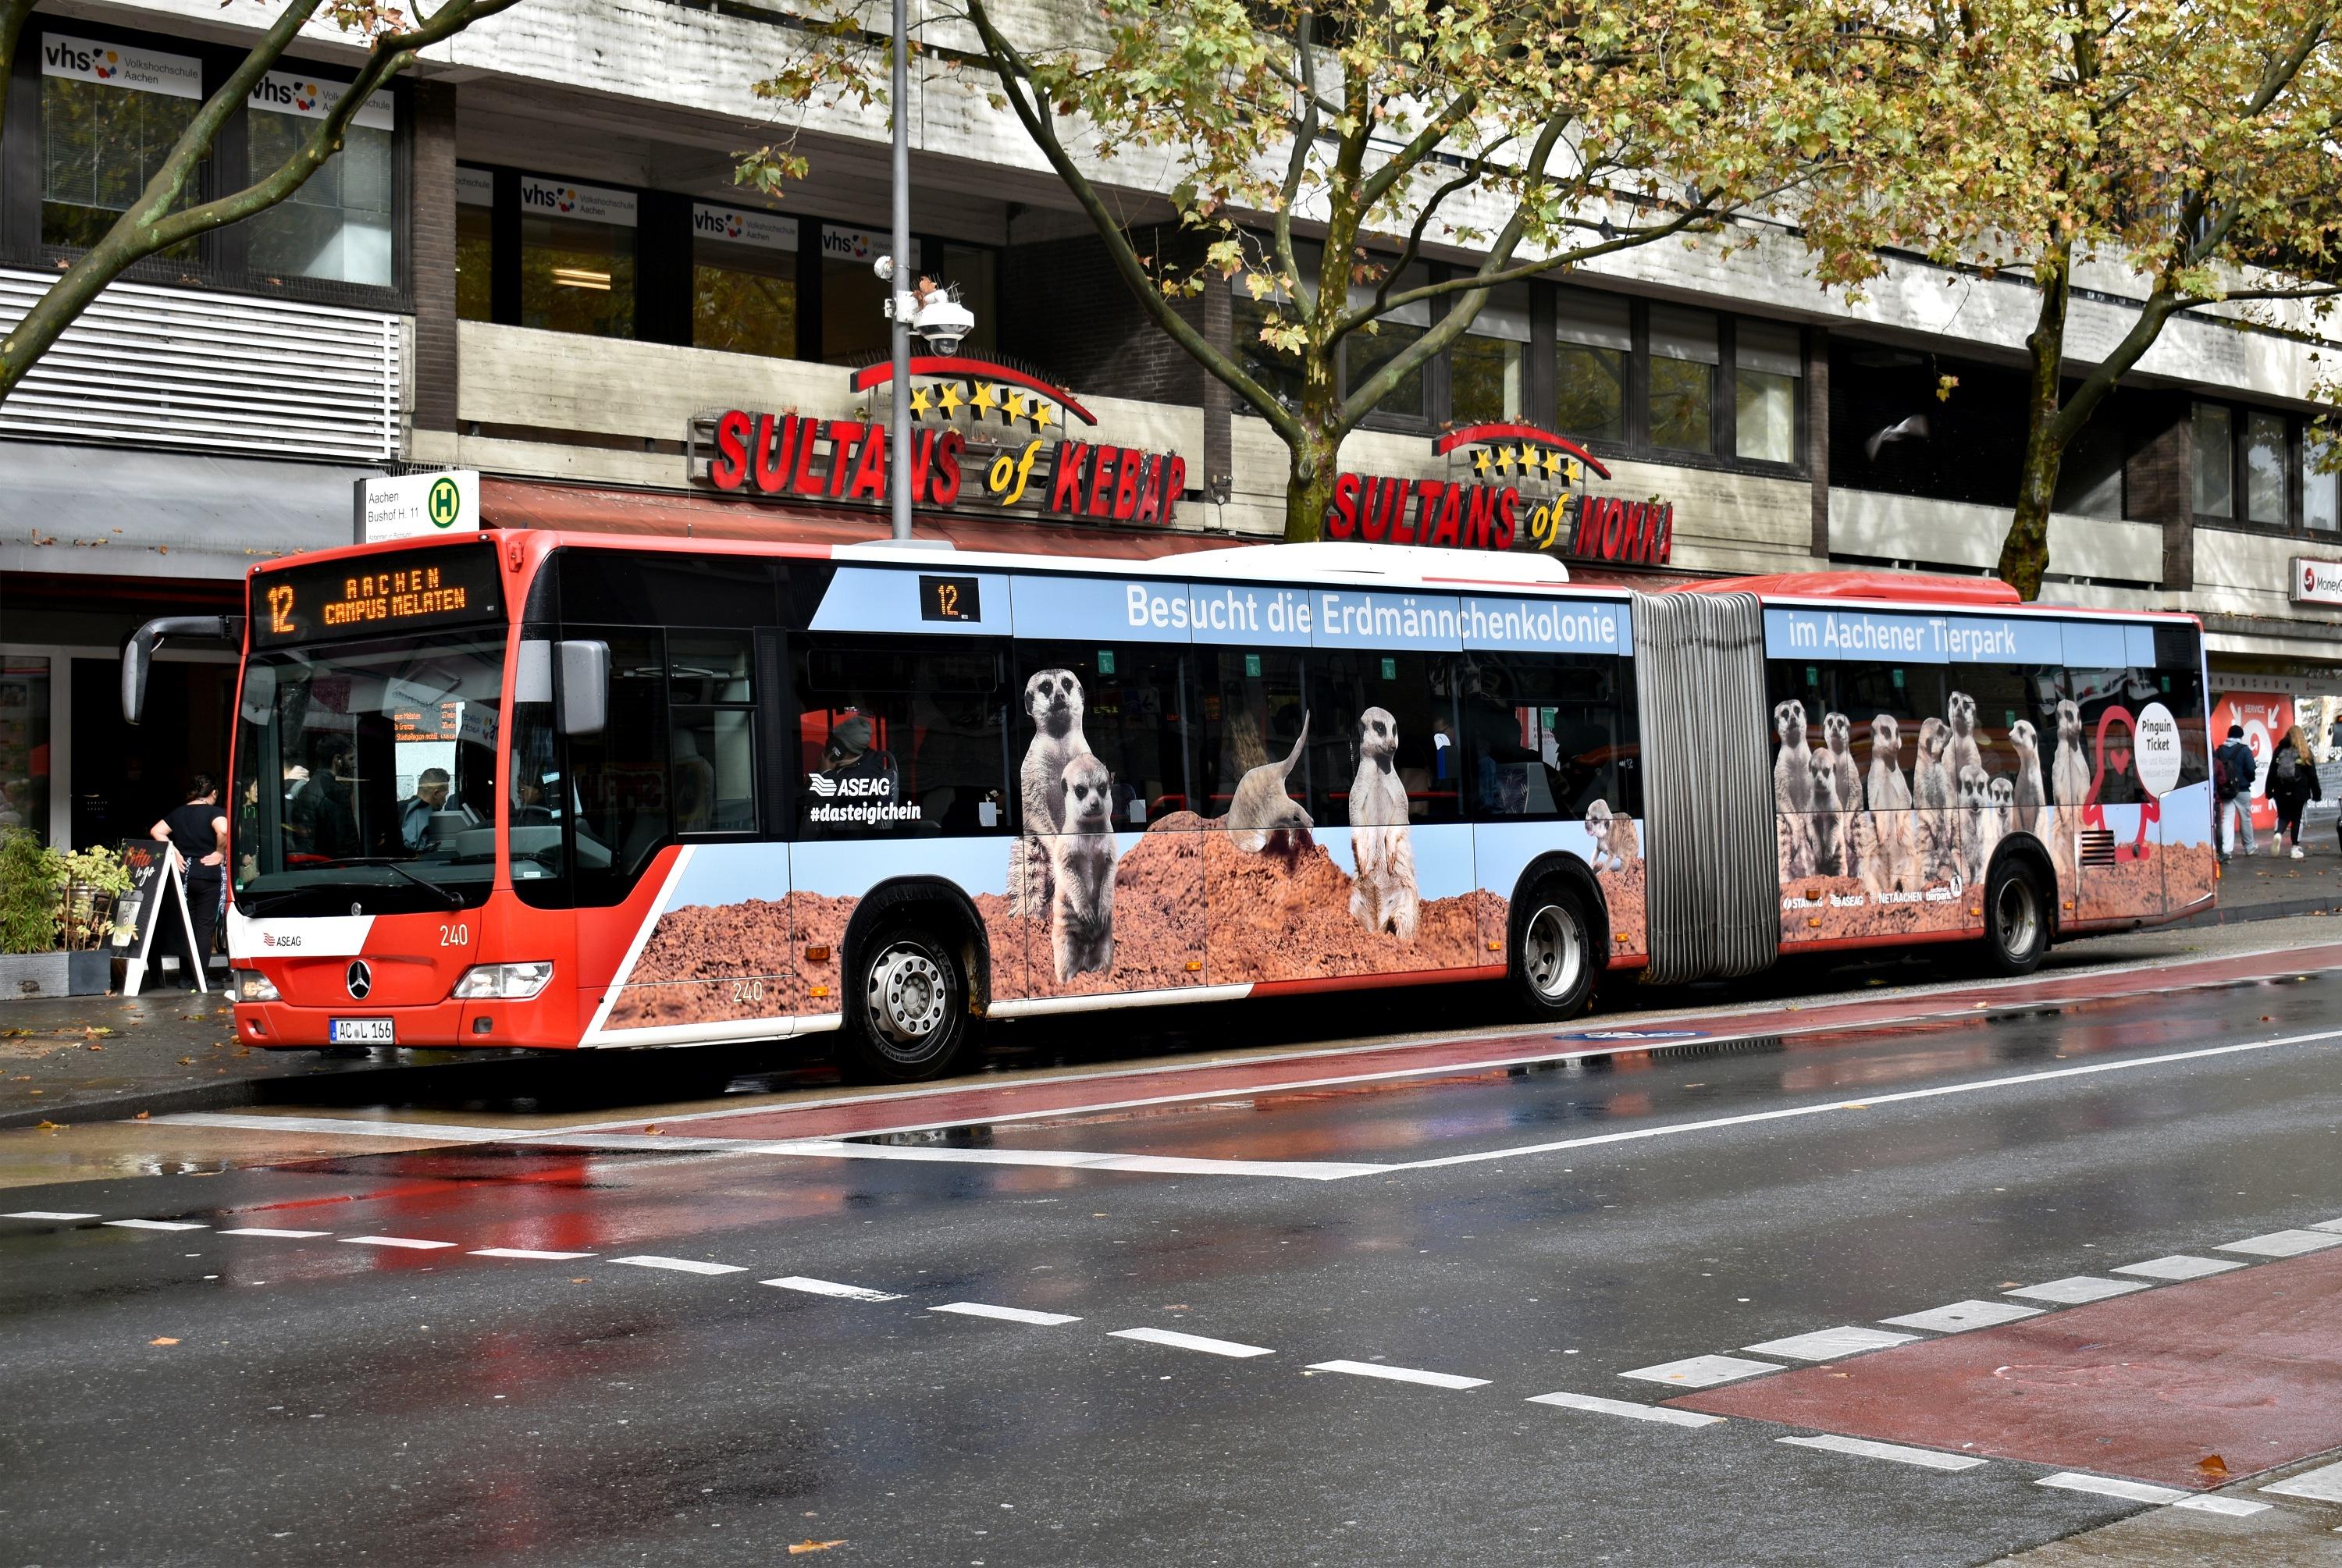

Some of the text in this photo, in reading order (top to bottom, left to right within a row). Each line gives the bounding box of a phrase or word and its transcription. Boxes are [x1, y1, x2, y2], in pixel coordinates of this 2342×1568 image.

[45, 42, 91, 72] vhs
[125, 57, 198, 79] Volkshochschule
[124, 70, 158, 84] Aachen
[252, 76, 292, 105] vhs
[322, 90, 391, 111] Volkschule
[522, 184, 556, 208] vhs
[580, 194, 635, 211] Volkshochschule
[580, 206, 606, 216] Aachen
[694, 211, 724, 233] vhs
[746, 231, 770, 241] Aachen
[822, 231, 852, 253] vhs
[707, 409, 1187, 526] SULTANS of KEBAP
[368, 492, 399, 504] Aachen
[368, 507, 418, 522] Bushof H. 11
[1328, 472, 1674, 564] SULTANS of MOKKA
[347, 567, 440, 599] AACHEN
[268, 585, 294, 633] 12
[325, 588, 466, 624] CAMPUS MELATEN
[938, 585, 959, 615] 12
[1127, 584, 1615, 644] Besucht die Erdmännchenkolonie
[1789, 613, 2016, 661] im Aachener Tierpark
[2244, 705, 2265, 714] SERVICE
[2142, 719, 2172, 735] Pinguin
[2146, 738, 2169, 751] Ticket
[838, 778, 890, 797] ASEAG
[810, 801, 921, 825] #dasteigichein
[2251, 805, 2262, 813] OINT
[139, 866, 156, 887] go
[1841, 895, 1863, 907] ASEAG
[276, 936, 301, 948] ASEAG
[440, 923, 468, 947] 240
[732, 981, 763, 1003] 240
[340, 1022, 352, 1038] AC
[361, 1022, 368, 1038] L
[372, 1022, 391, 1038] 166
